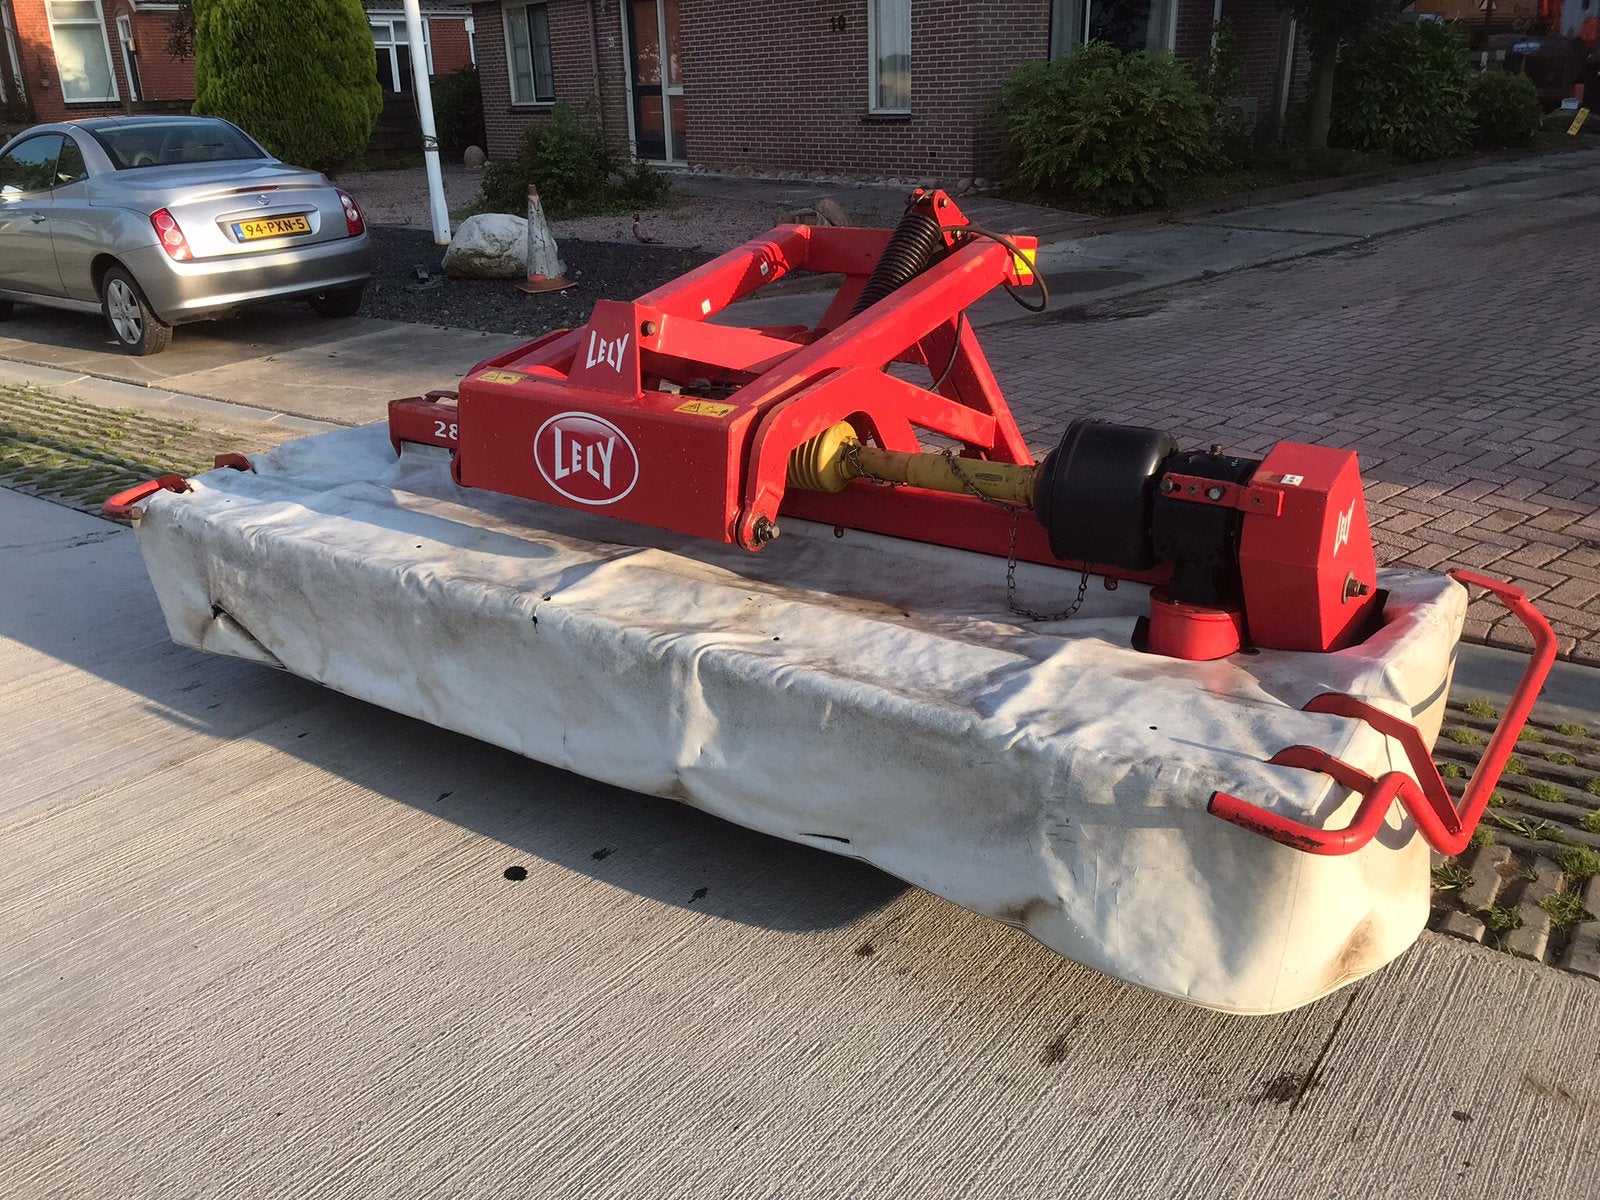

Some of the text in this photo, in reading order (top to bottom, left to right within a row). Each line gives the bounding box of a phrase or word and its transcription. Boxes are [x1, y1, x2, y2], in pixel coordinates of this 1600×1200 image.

[245, 218, 306, 236] 94-PXN-5
[585, 330, 630, 374] LELY
[434, 420, 458, 441] 28
[554, 426, 616, 490] LELY
